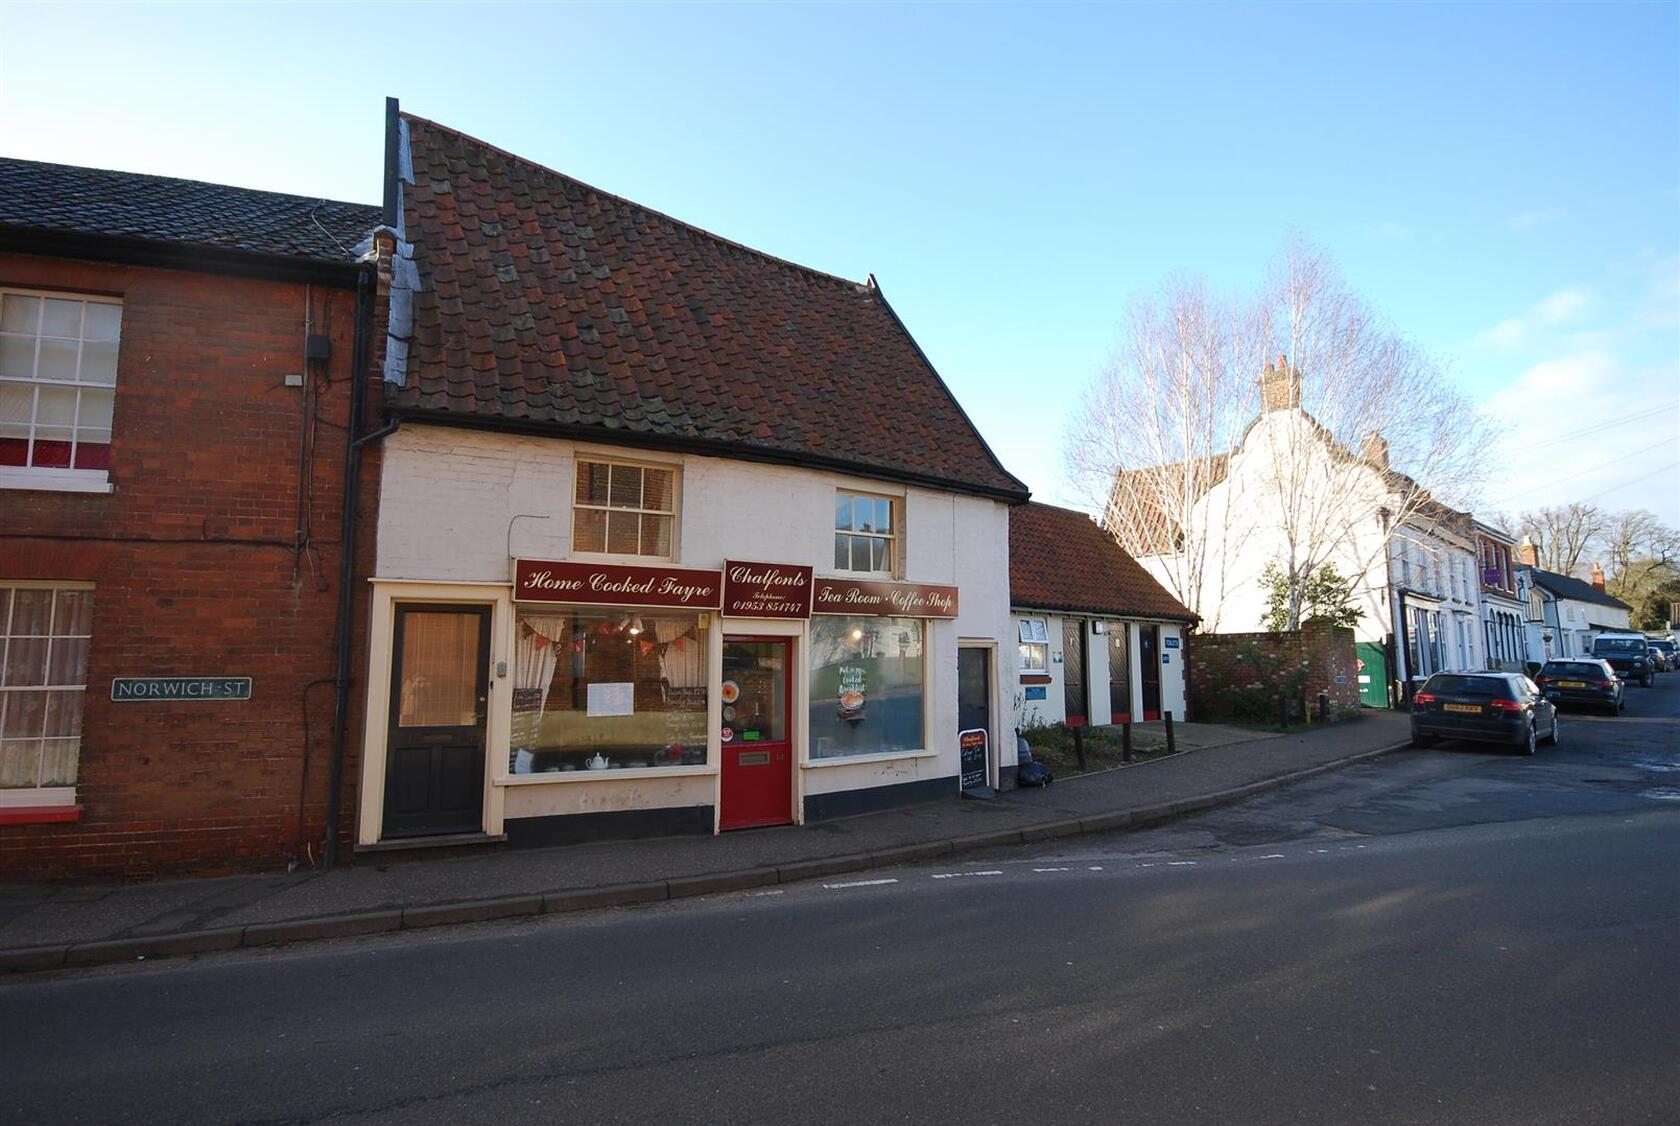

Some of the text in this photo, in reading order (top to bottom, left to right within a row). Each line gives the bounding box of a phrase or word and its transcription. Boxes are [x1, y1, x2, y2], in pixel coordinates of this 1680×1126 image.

[523, 571, 714, 603] Home Cooked Fayre
[730, 566, 808, 591] Chalfonts
[733, 601, 802, 613] 01953 851747
[819, 586, 952, 612] Tea Room Coffee Shop
[119, 682, 245, 696] NORWICH ST
